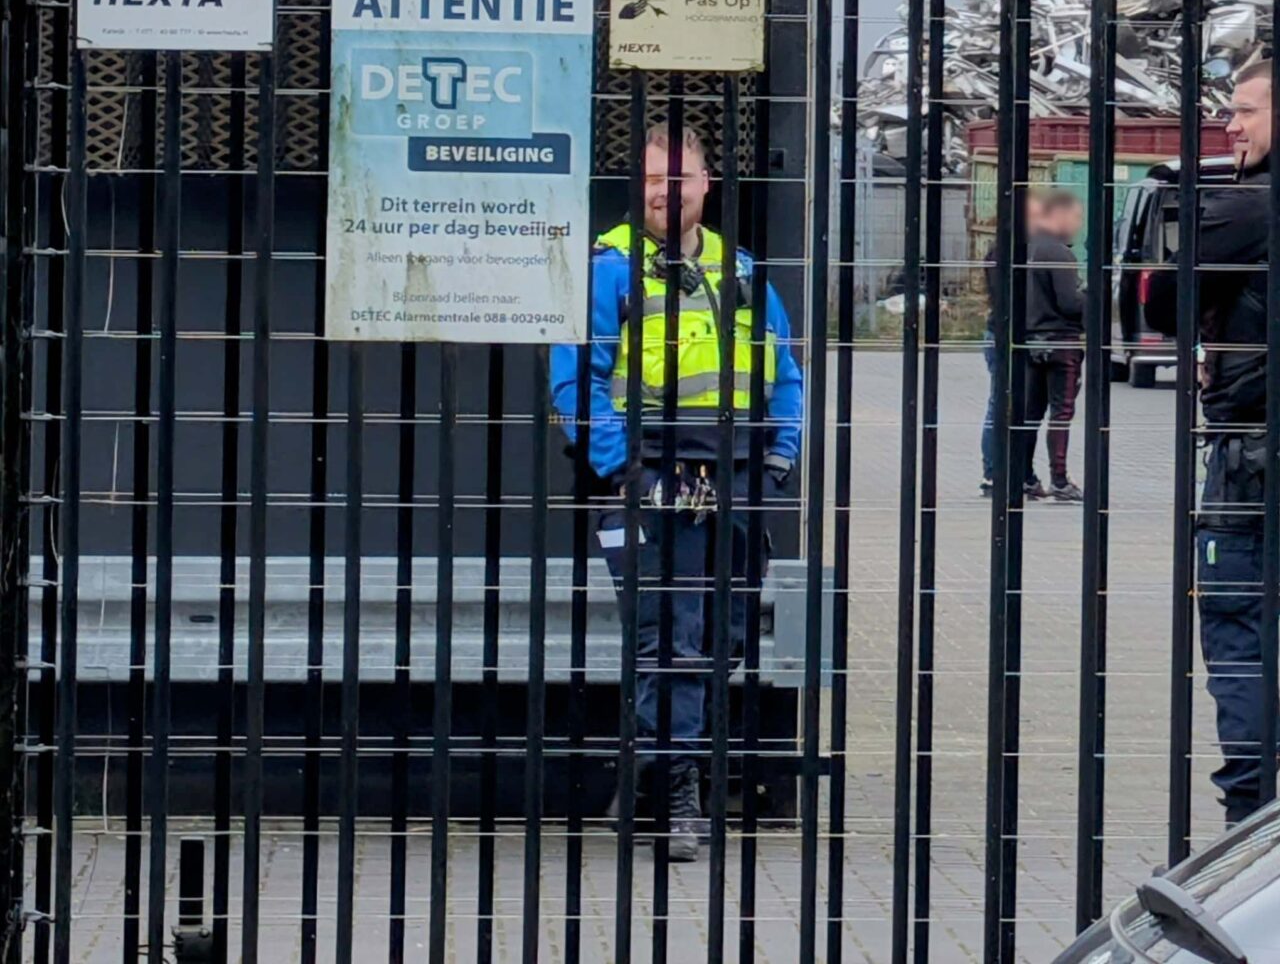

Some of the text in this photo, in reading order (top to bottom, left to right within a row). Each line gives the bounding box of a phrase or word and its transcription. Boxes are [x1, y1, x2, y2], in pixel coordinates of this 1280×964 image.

[618, 43, 661, 53] HEXTA
[361, 59, 522, 108] DETEC
[397, 113, 486, 130] GROEP
[425, 145, 554, 163] BEVEILIGING
[380, 197, 536, 215] Dit terrein wordt
[344, 219, 571, 240] 24 uur per dag beveiligd
[366, 252, 402, 263] Alleen
[406, 253, 454, 266] ogang
[453, 293, 489, 304] bellen
[492, 294, 521, 305] naar:
[350, 309, 391, 322] DETEC
[394, 310, 481, 323] Alarmcentrale
